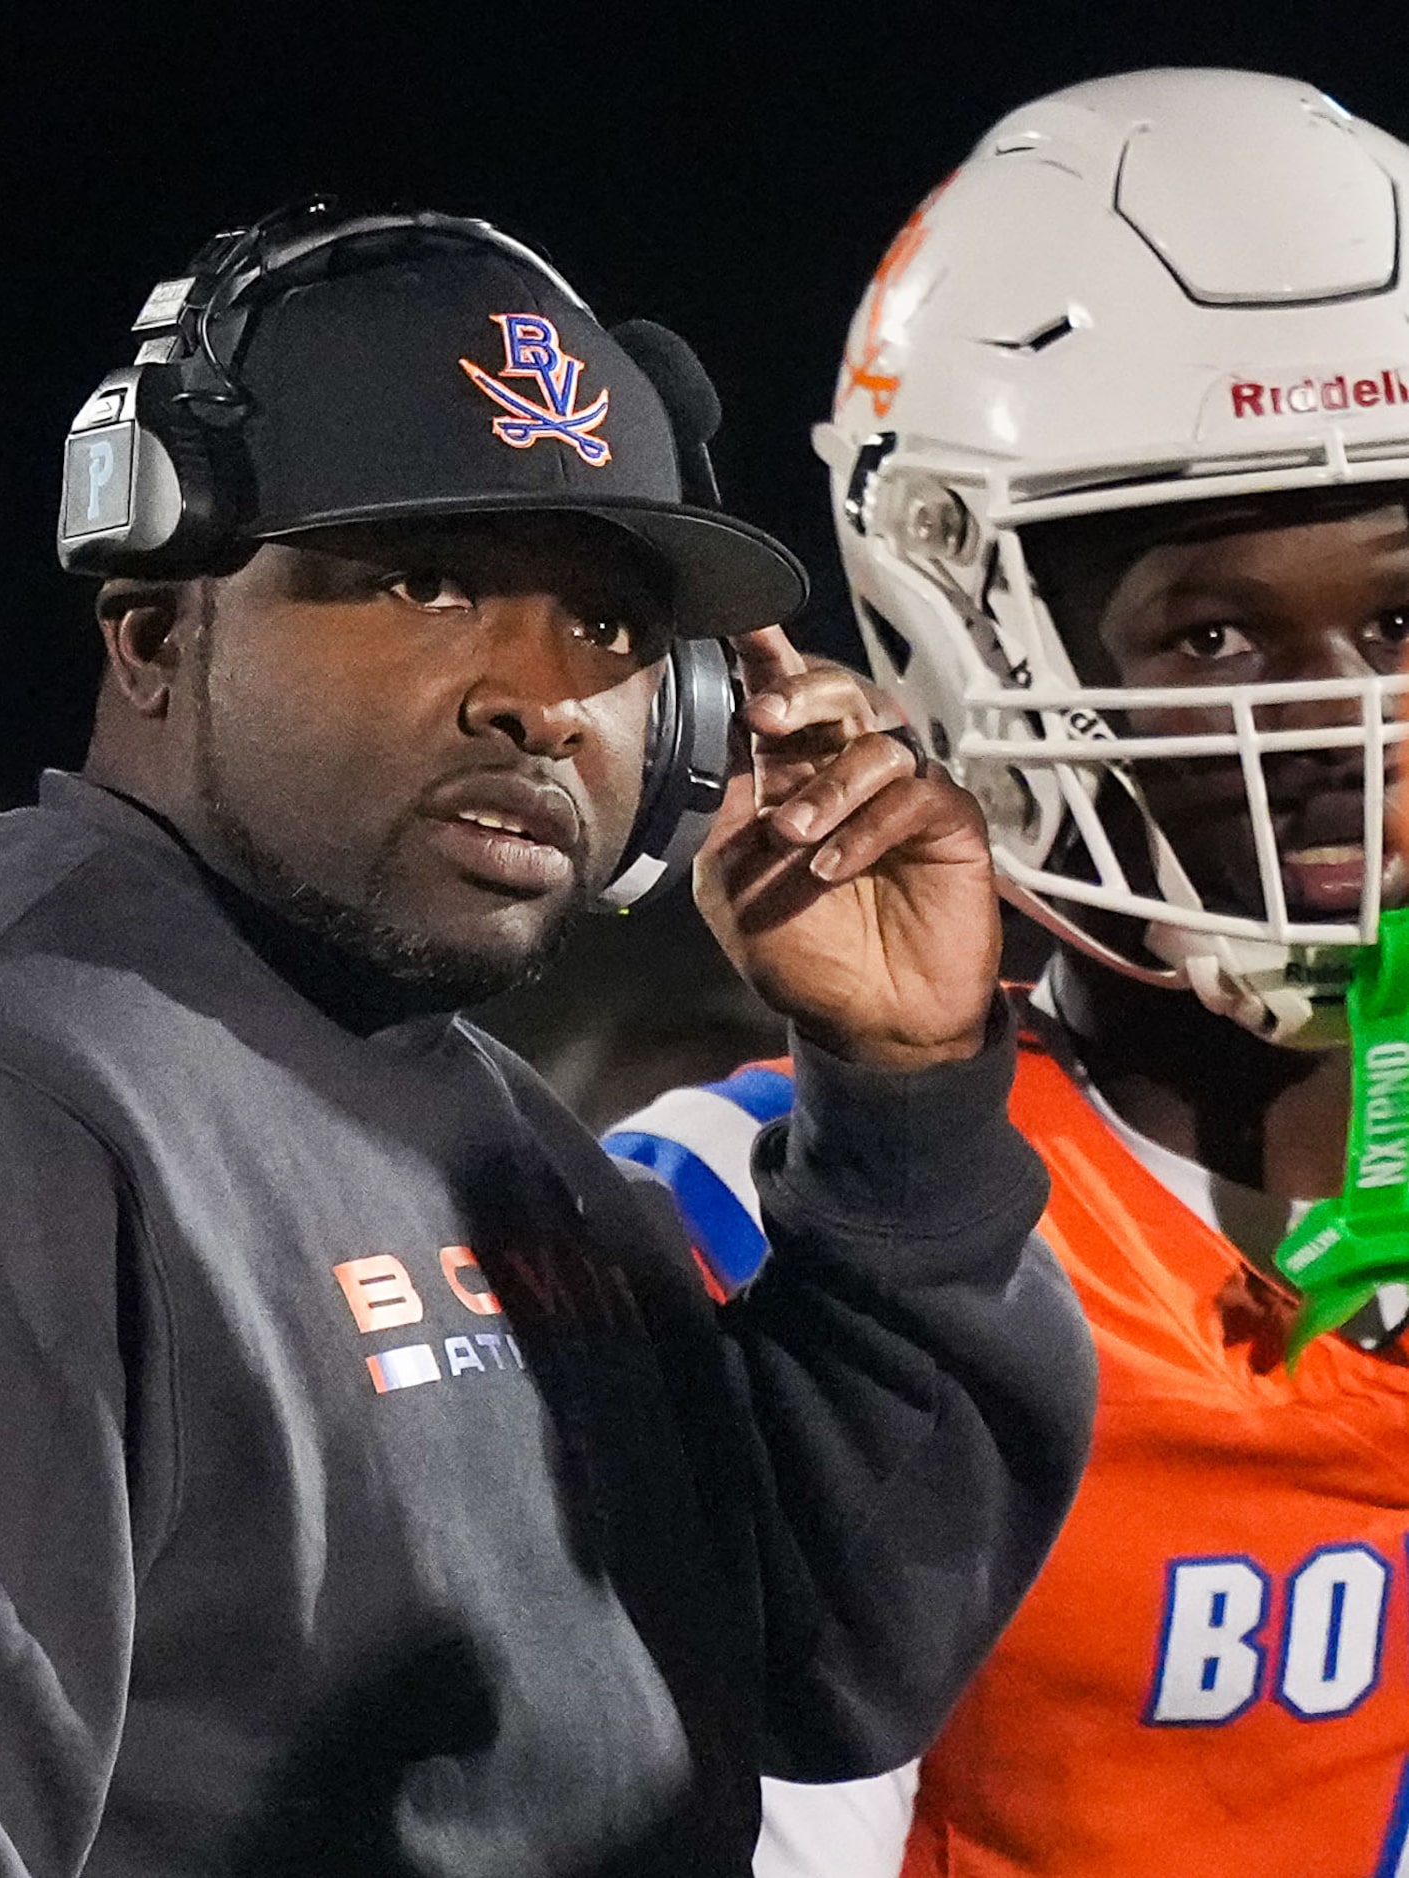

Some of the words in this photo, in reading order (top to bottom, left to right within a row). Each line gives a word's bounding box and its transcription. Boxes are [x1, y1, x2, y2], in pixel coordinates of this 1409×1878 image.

[489, 312, 585, 417] BV
[87, 440, 114, 521] P
[1140, 1541, 1409, 1728] BO
